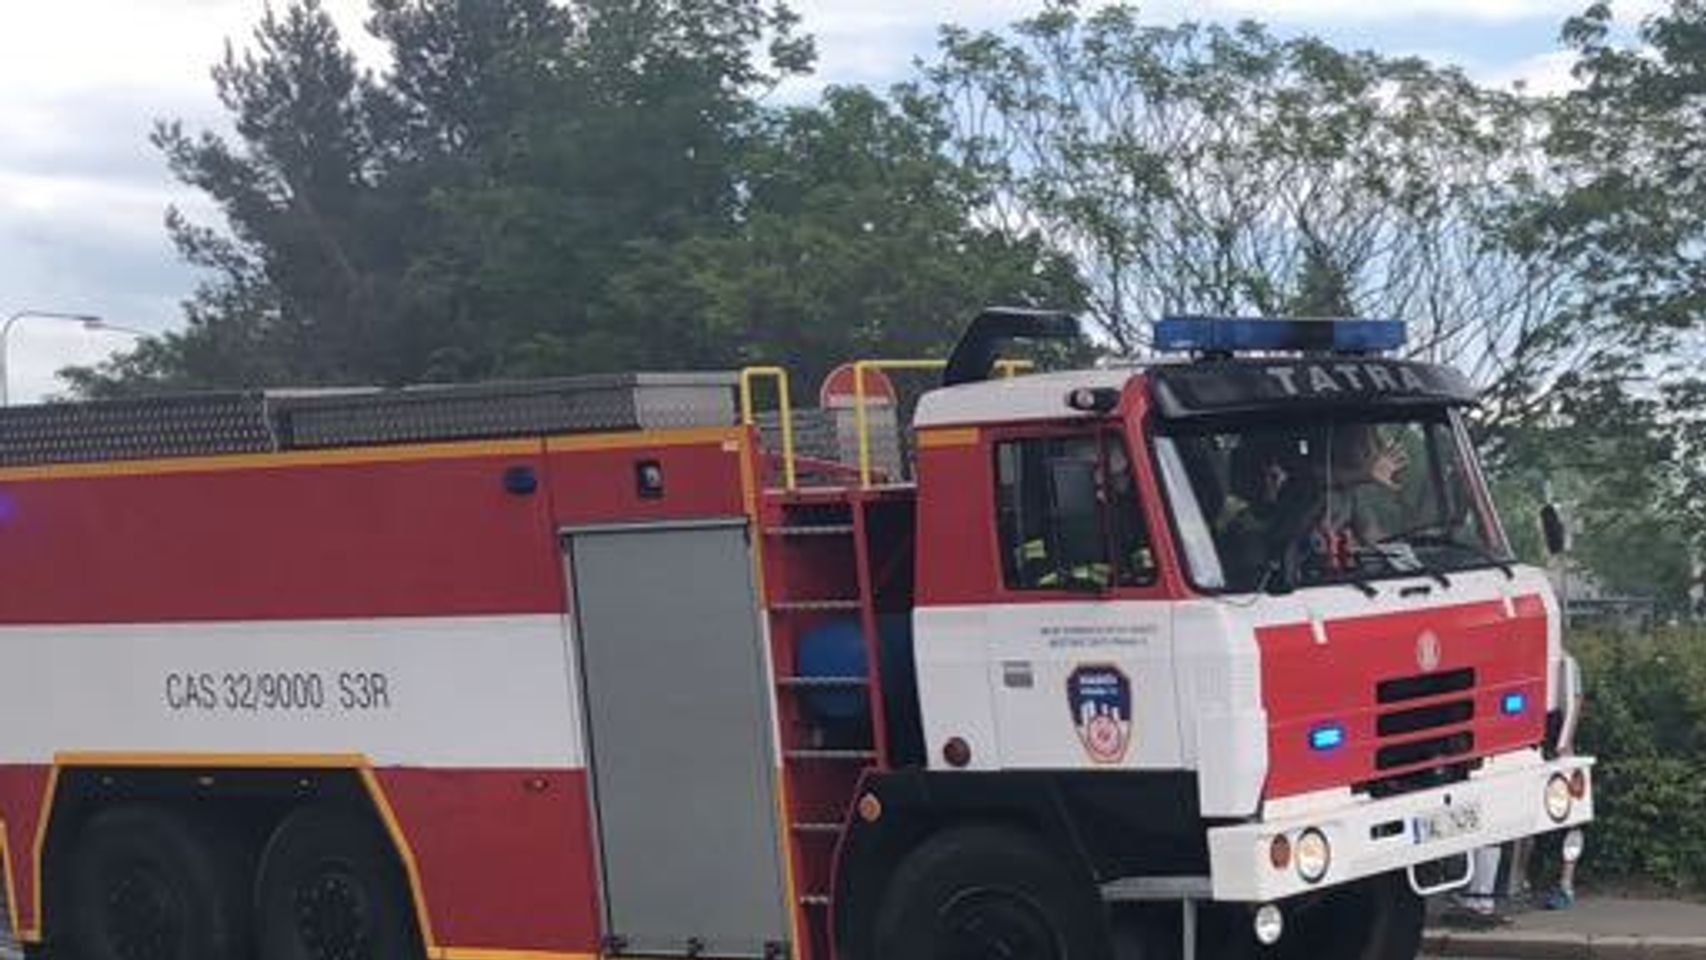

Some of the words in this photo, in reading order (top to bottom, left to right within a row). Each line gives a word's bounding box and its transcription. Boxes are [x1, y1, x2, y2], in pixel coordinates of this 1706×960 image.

[1266, 362, 1426, 396] TATRA
[165, 672, 217, 709] CAS
[223, 672, 324, 710] 32/9000
[338, 672, 390, 709] S3R
